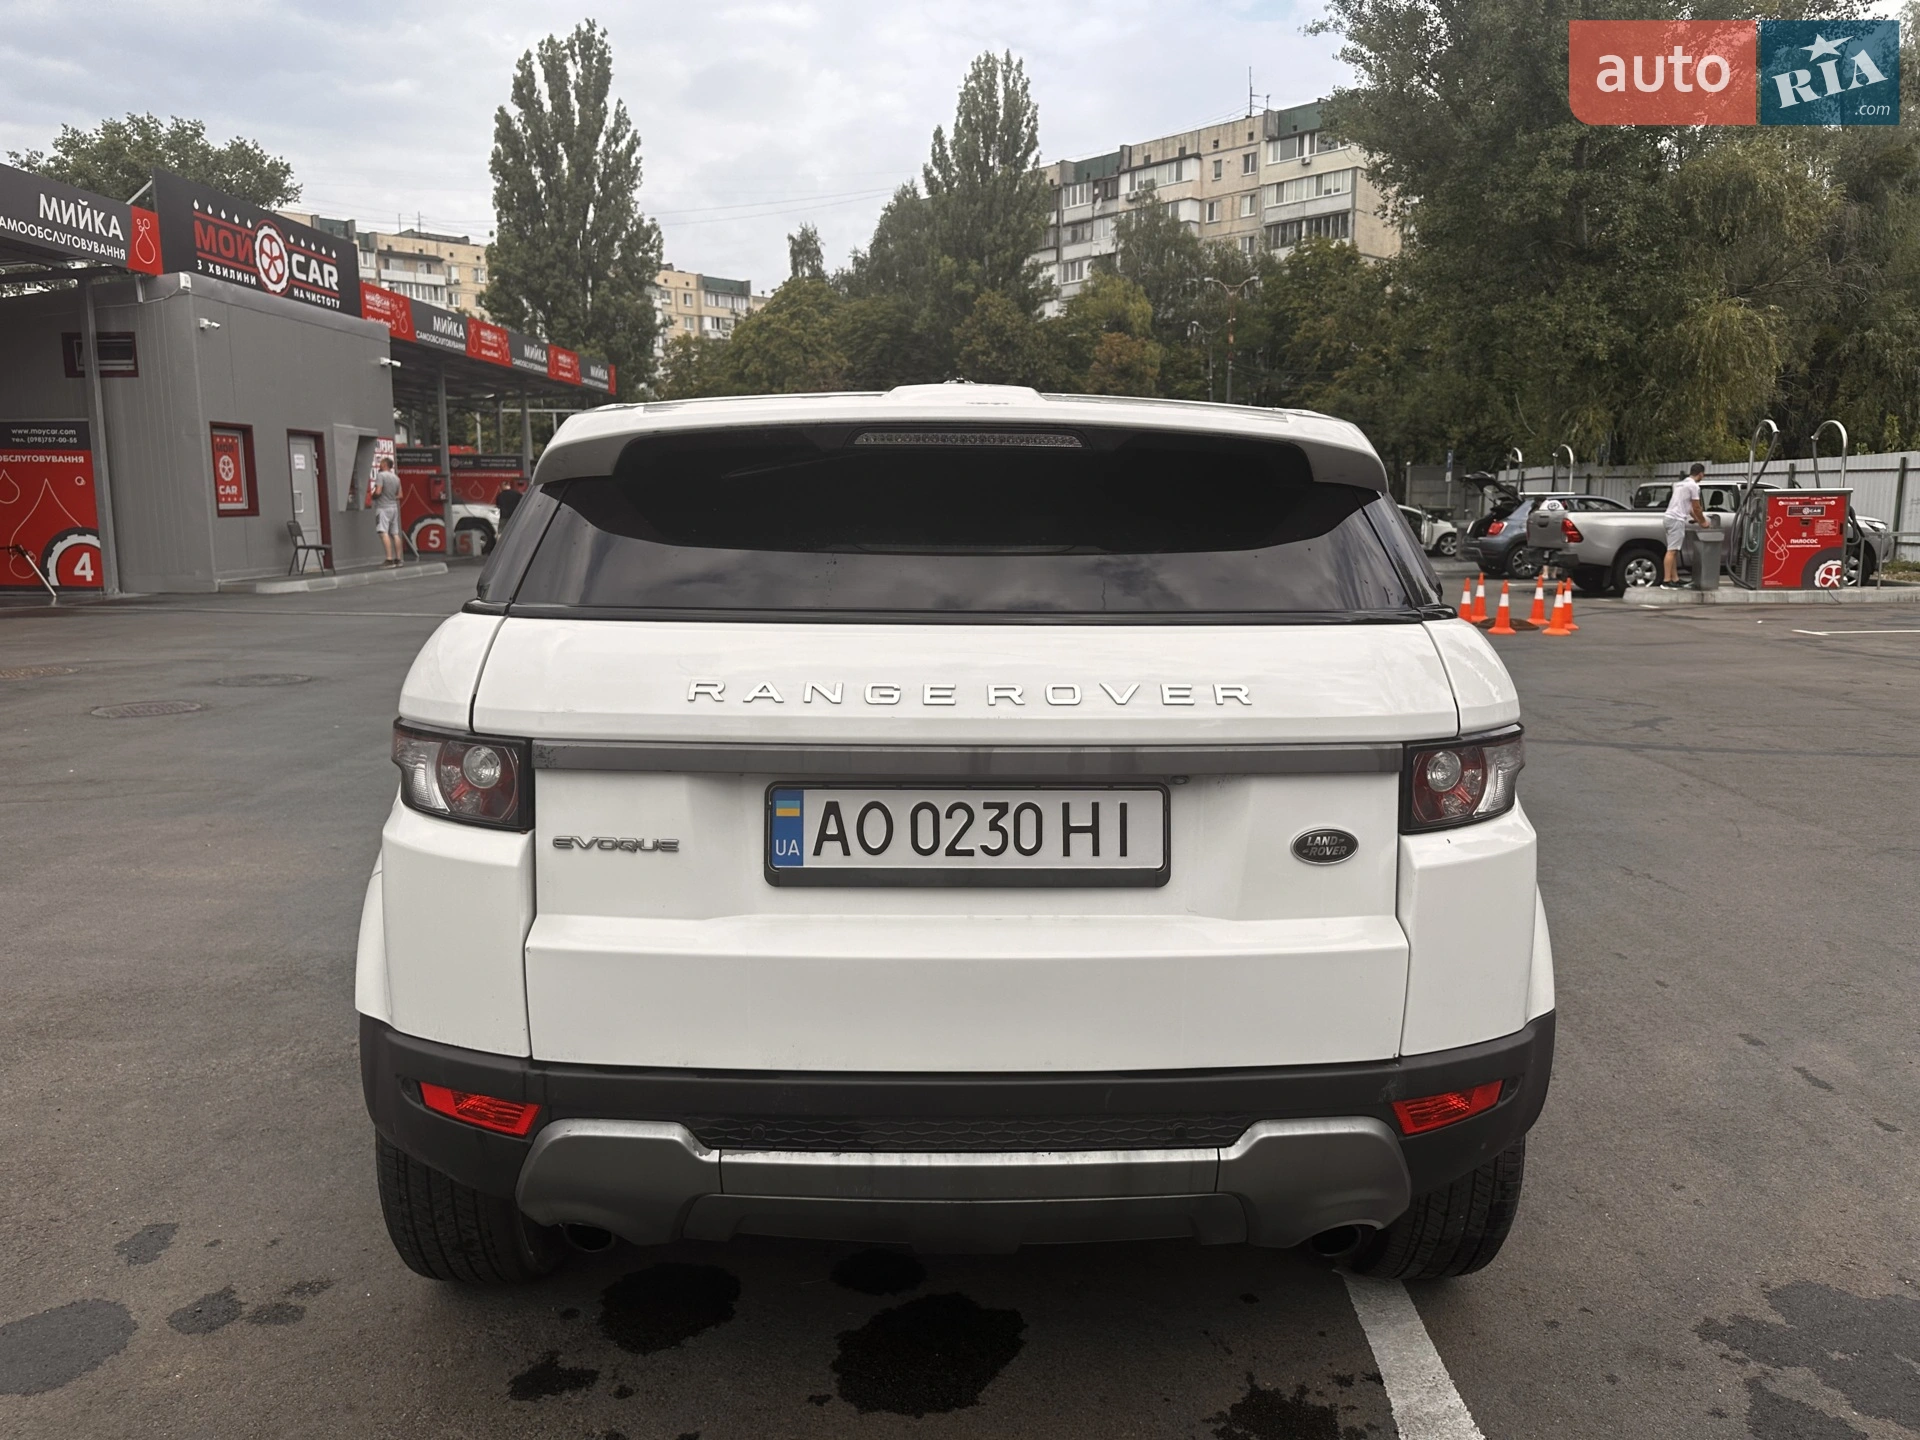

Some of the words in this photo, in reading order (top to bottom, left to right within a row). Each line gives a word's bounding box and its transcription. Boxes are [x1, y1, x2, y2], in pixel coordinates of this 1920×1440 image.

[39, 193, 124, 241] МИЙКА
[194, 220, 254, 264] МОЙ
[291, 252, 339, 291] CAR
[209, 263, 257, 285] ХВИЛИНИ
[294, 288, 304, 299] НА
[306, 291, 340, 309] ЧИСТОТУ
[433, 315, 465, 340] МИЙКА
[524, 344, 547, 363] МИЙКА
[11, 428, 76, 436] www.moycar.com
[219, 485, 238, 495] CAR
[428, 530, 441, 548] 5
[74, 552, 94, 582] 4
[687, 680, 957, 706] RANGE
[987, 683, 1253, 706] ROVER
[812, 801, 894, 857] AO
[910, 801, 1043, 857] 0230
[1062, 801, 1128, 857] HI
[552, 836, 679, 853] EVOQUE
[775, 839, 800, 857] UA
[1307, 836, 1338, 846] LAND
[1309, 846, 1347, 856] ROVER
